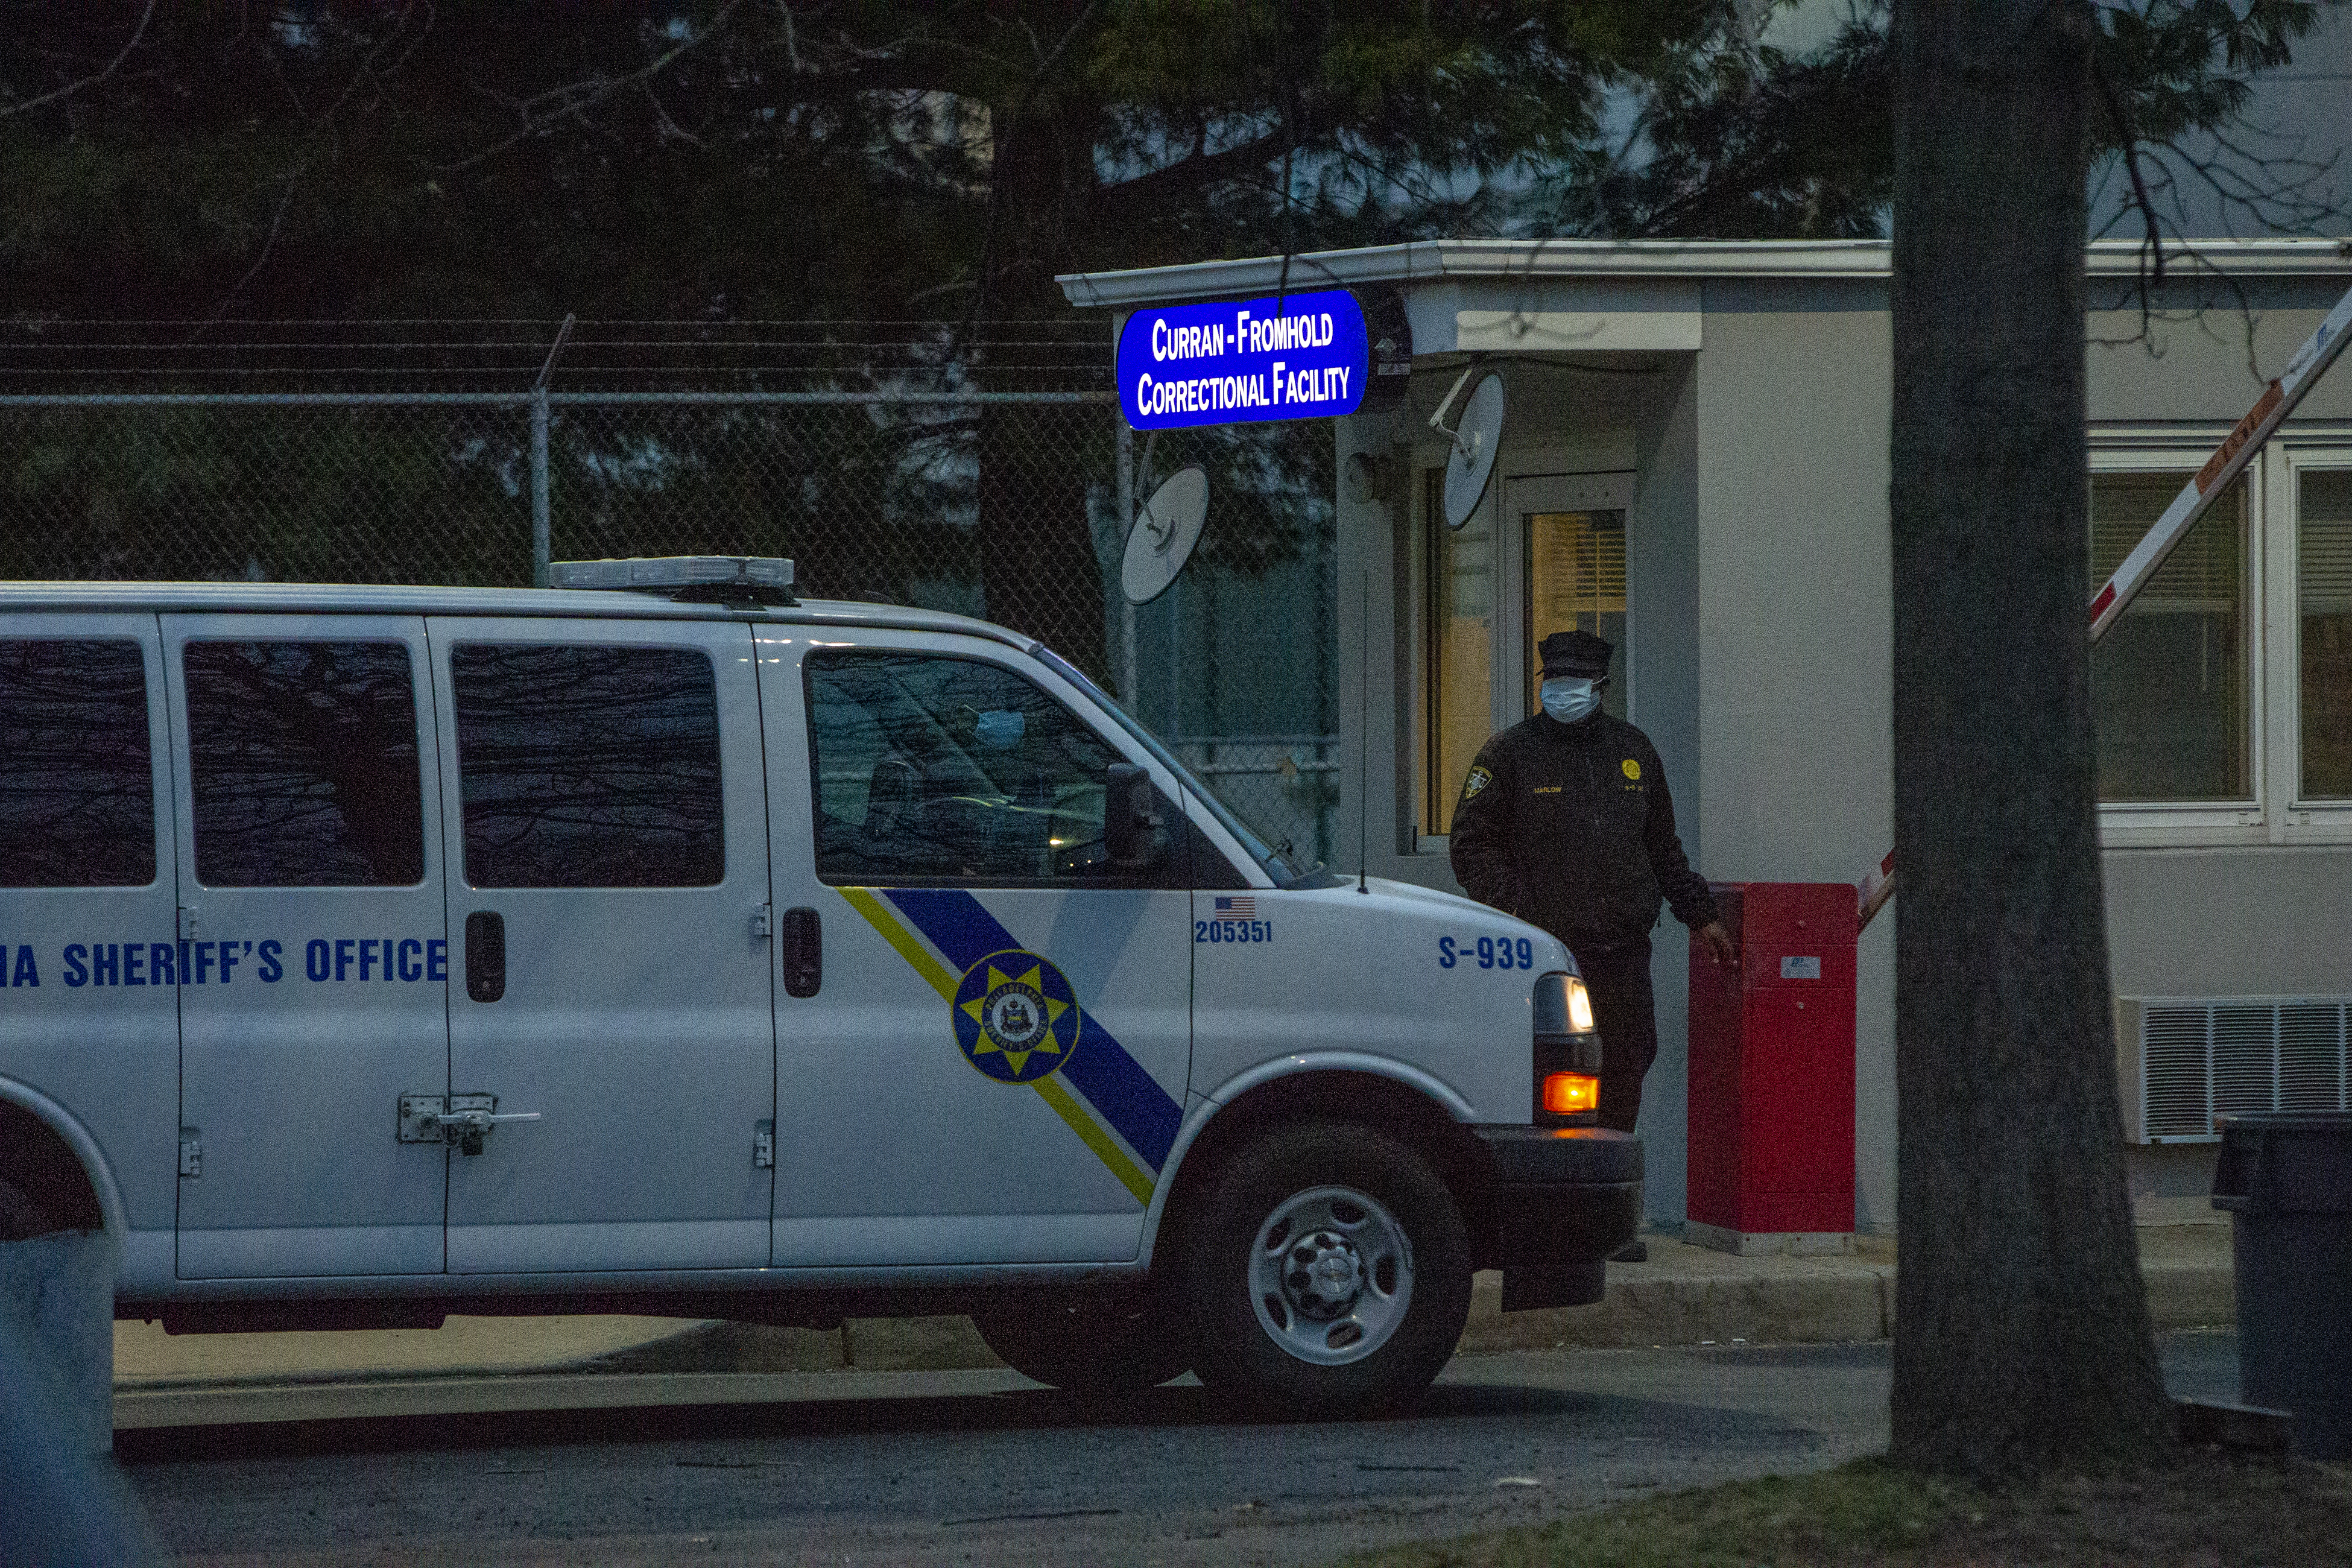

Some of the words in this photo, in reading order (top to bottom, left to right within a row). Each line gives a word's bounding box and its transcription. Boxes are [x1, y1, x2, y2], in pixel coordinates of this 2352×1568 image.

[1138, 373, 1269, 416] CORRECTIONAL
[1272, 362, 1350, 405] FACILITY
[1195, 920, 1272, 943] 205351
[63, 939, 283, 988] SHERIFF'S
[306, 938, 446, 982] OFFICE
[1439, 937, 1533, 970] S-939
